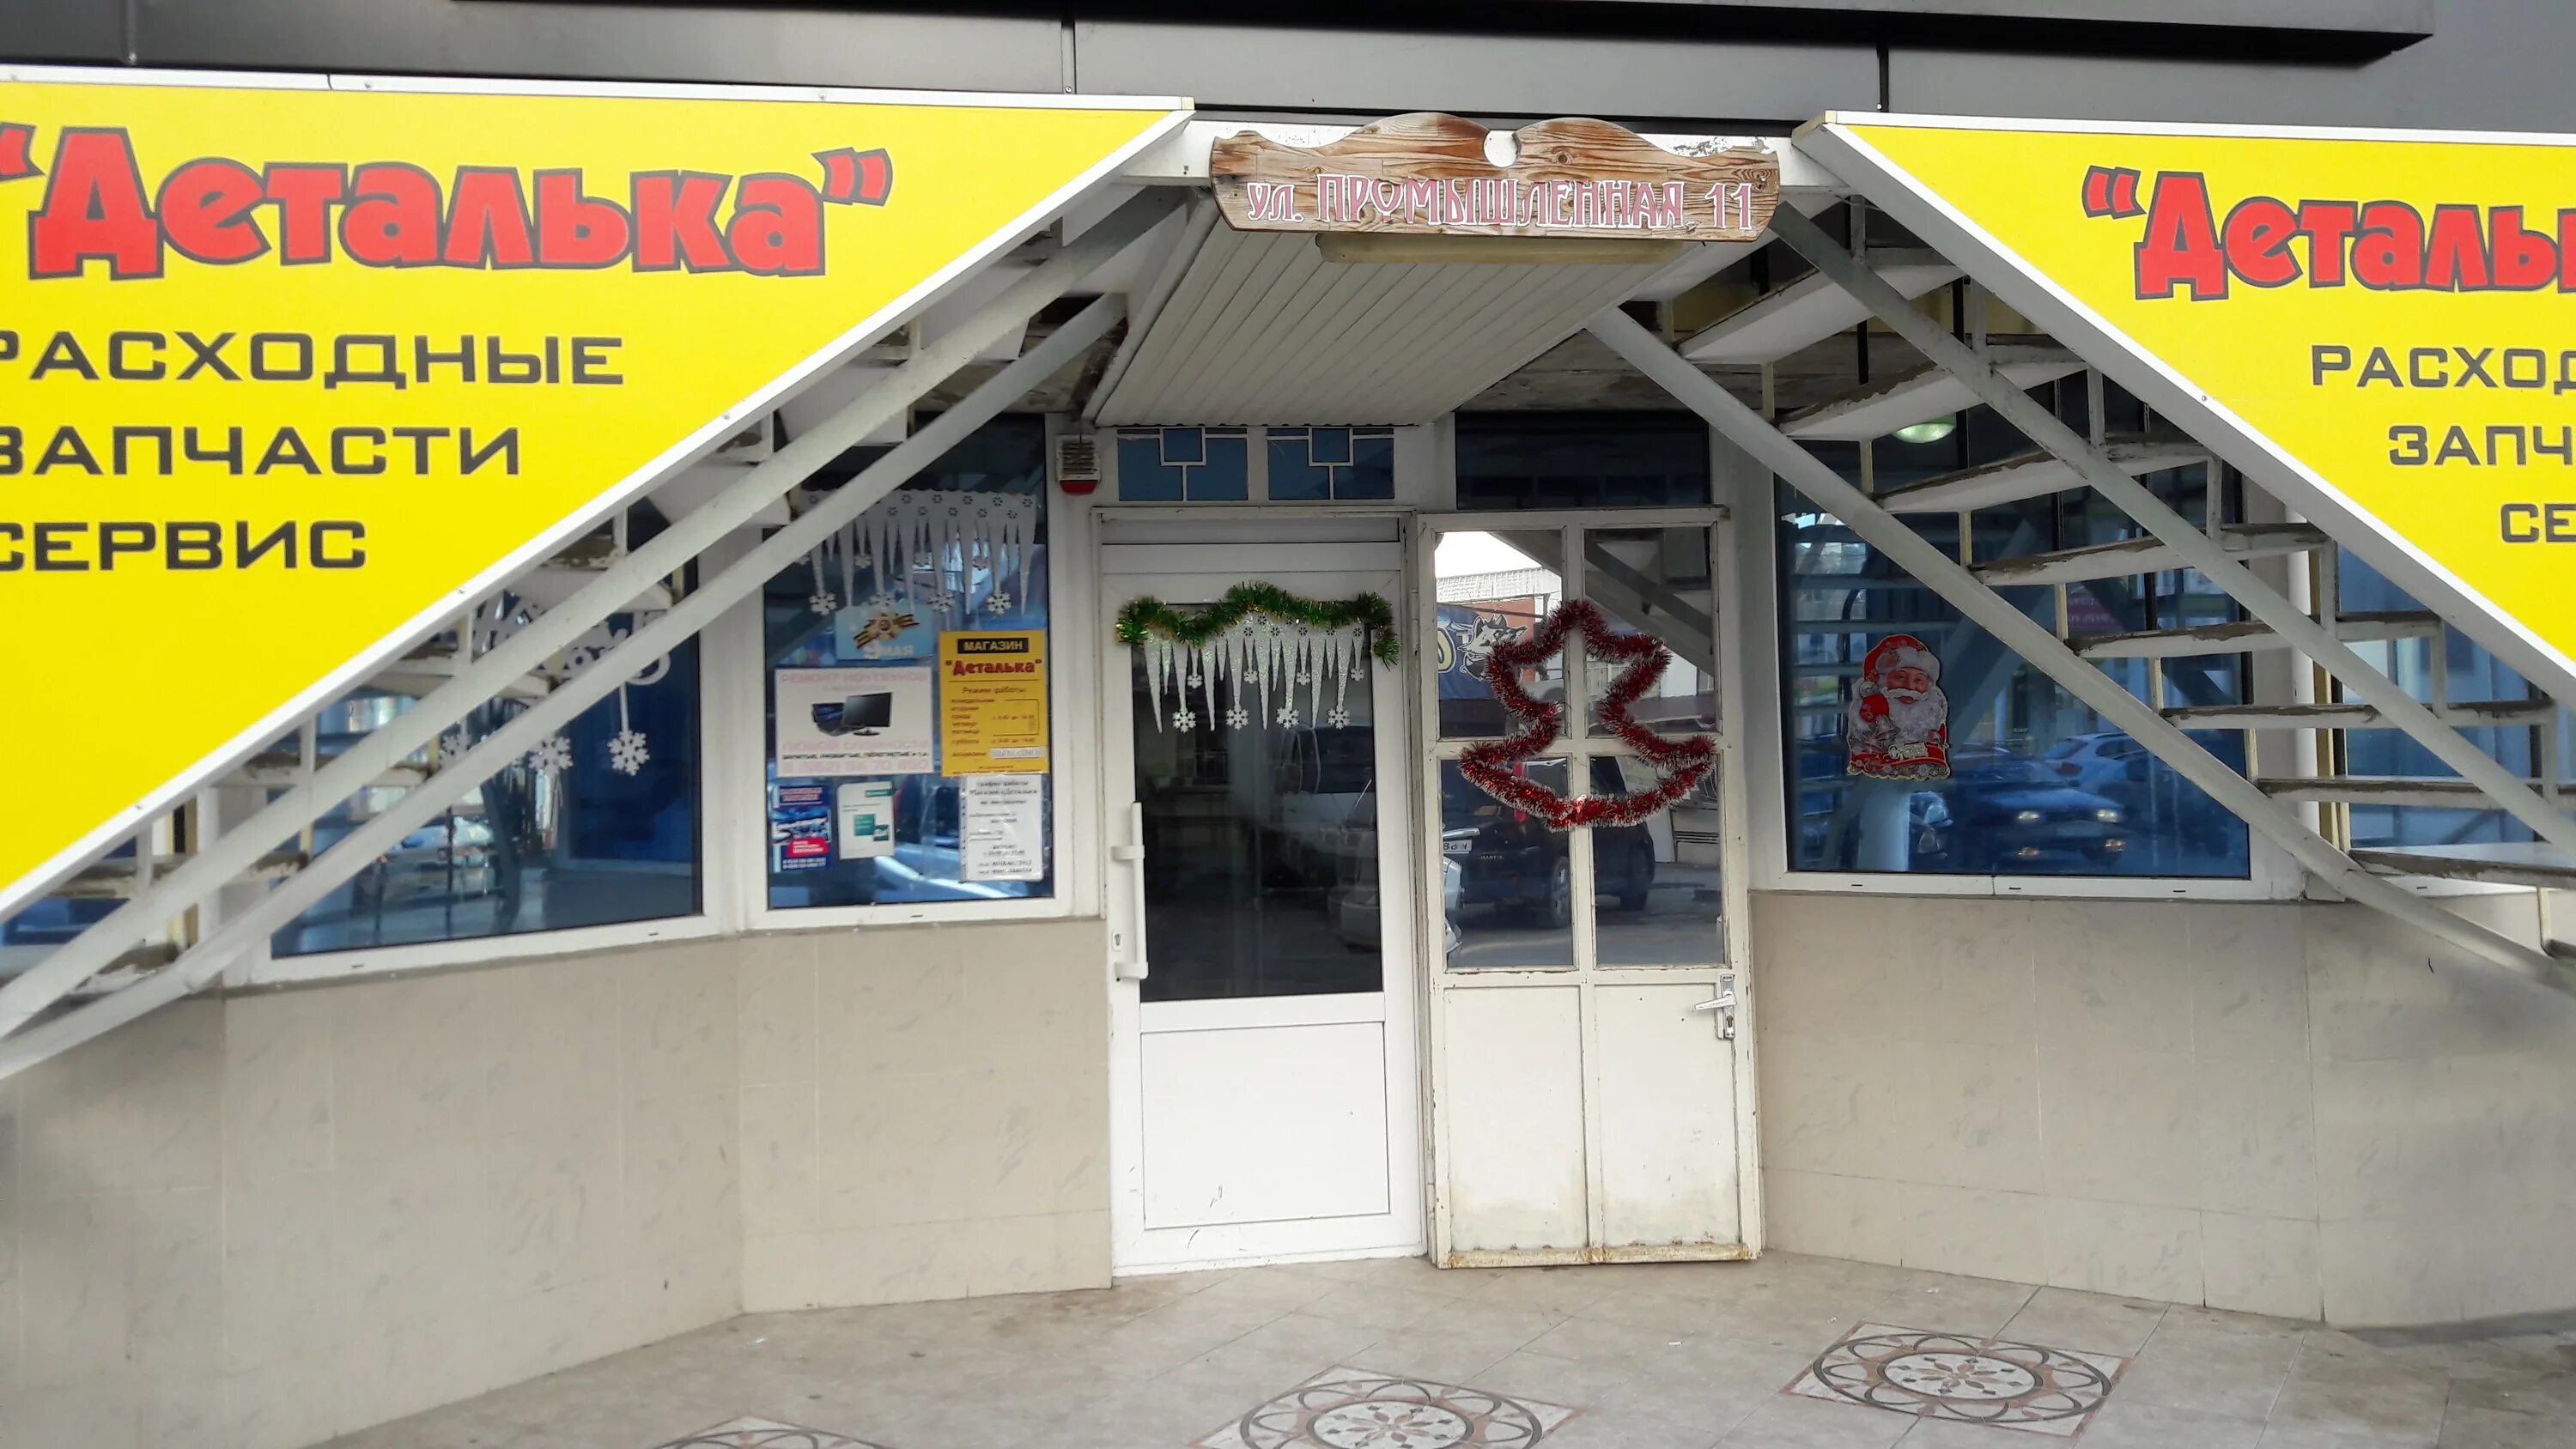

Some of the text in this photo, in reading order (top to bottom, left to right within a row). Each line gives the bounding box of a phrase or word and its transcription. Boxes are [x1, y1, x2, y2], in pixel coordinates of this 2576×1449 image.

[1248, 183, 1303, 221] ул.
[1704, 183, 1753, 229] 11
[963, 641, 1024, 652] МАГАЗИН
[945, 658, 1042, 676] "Деталька"
